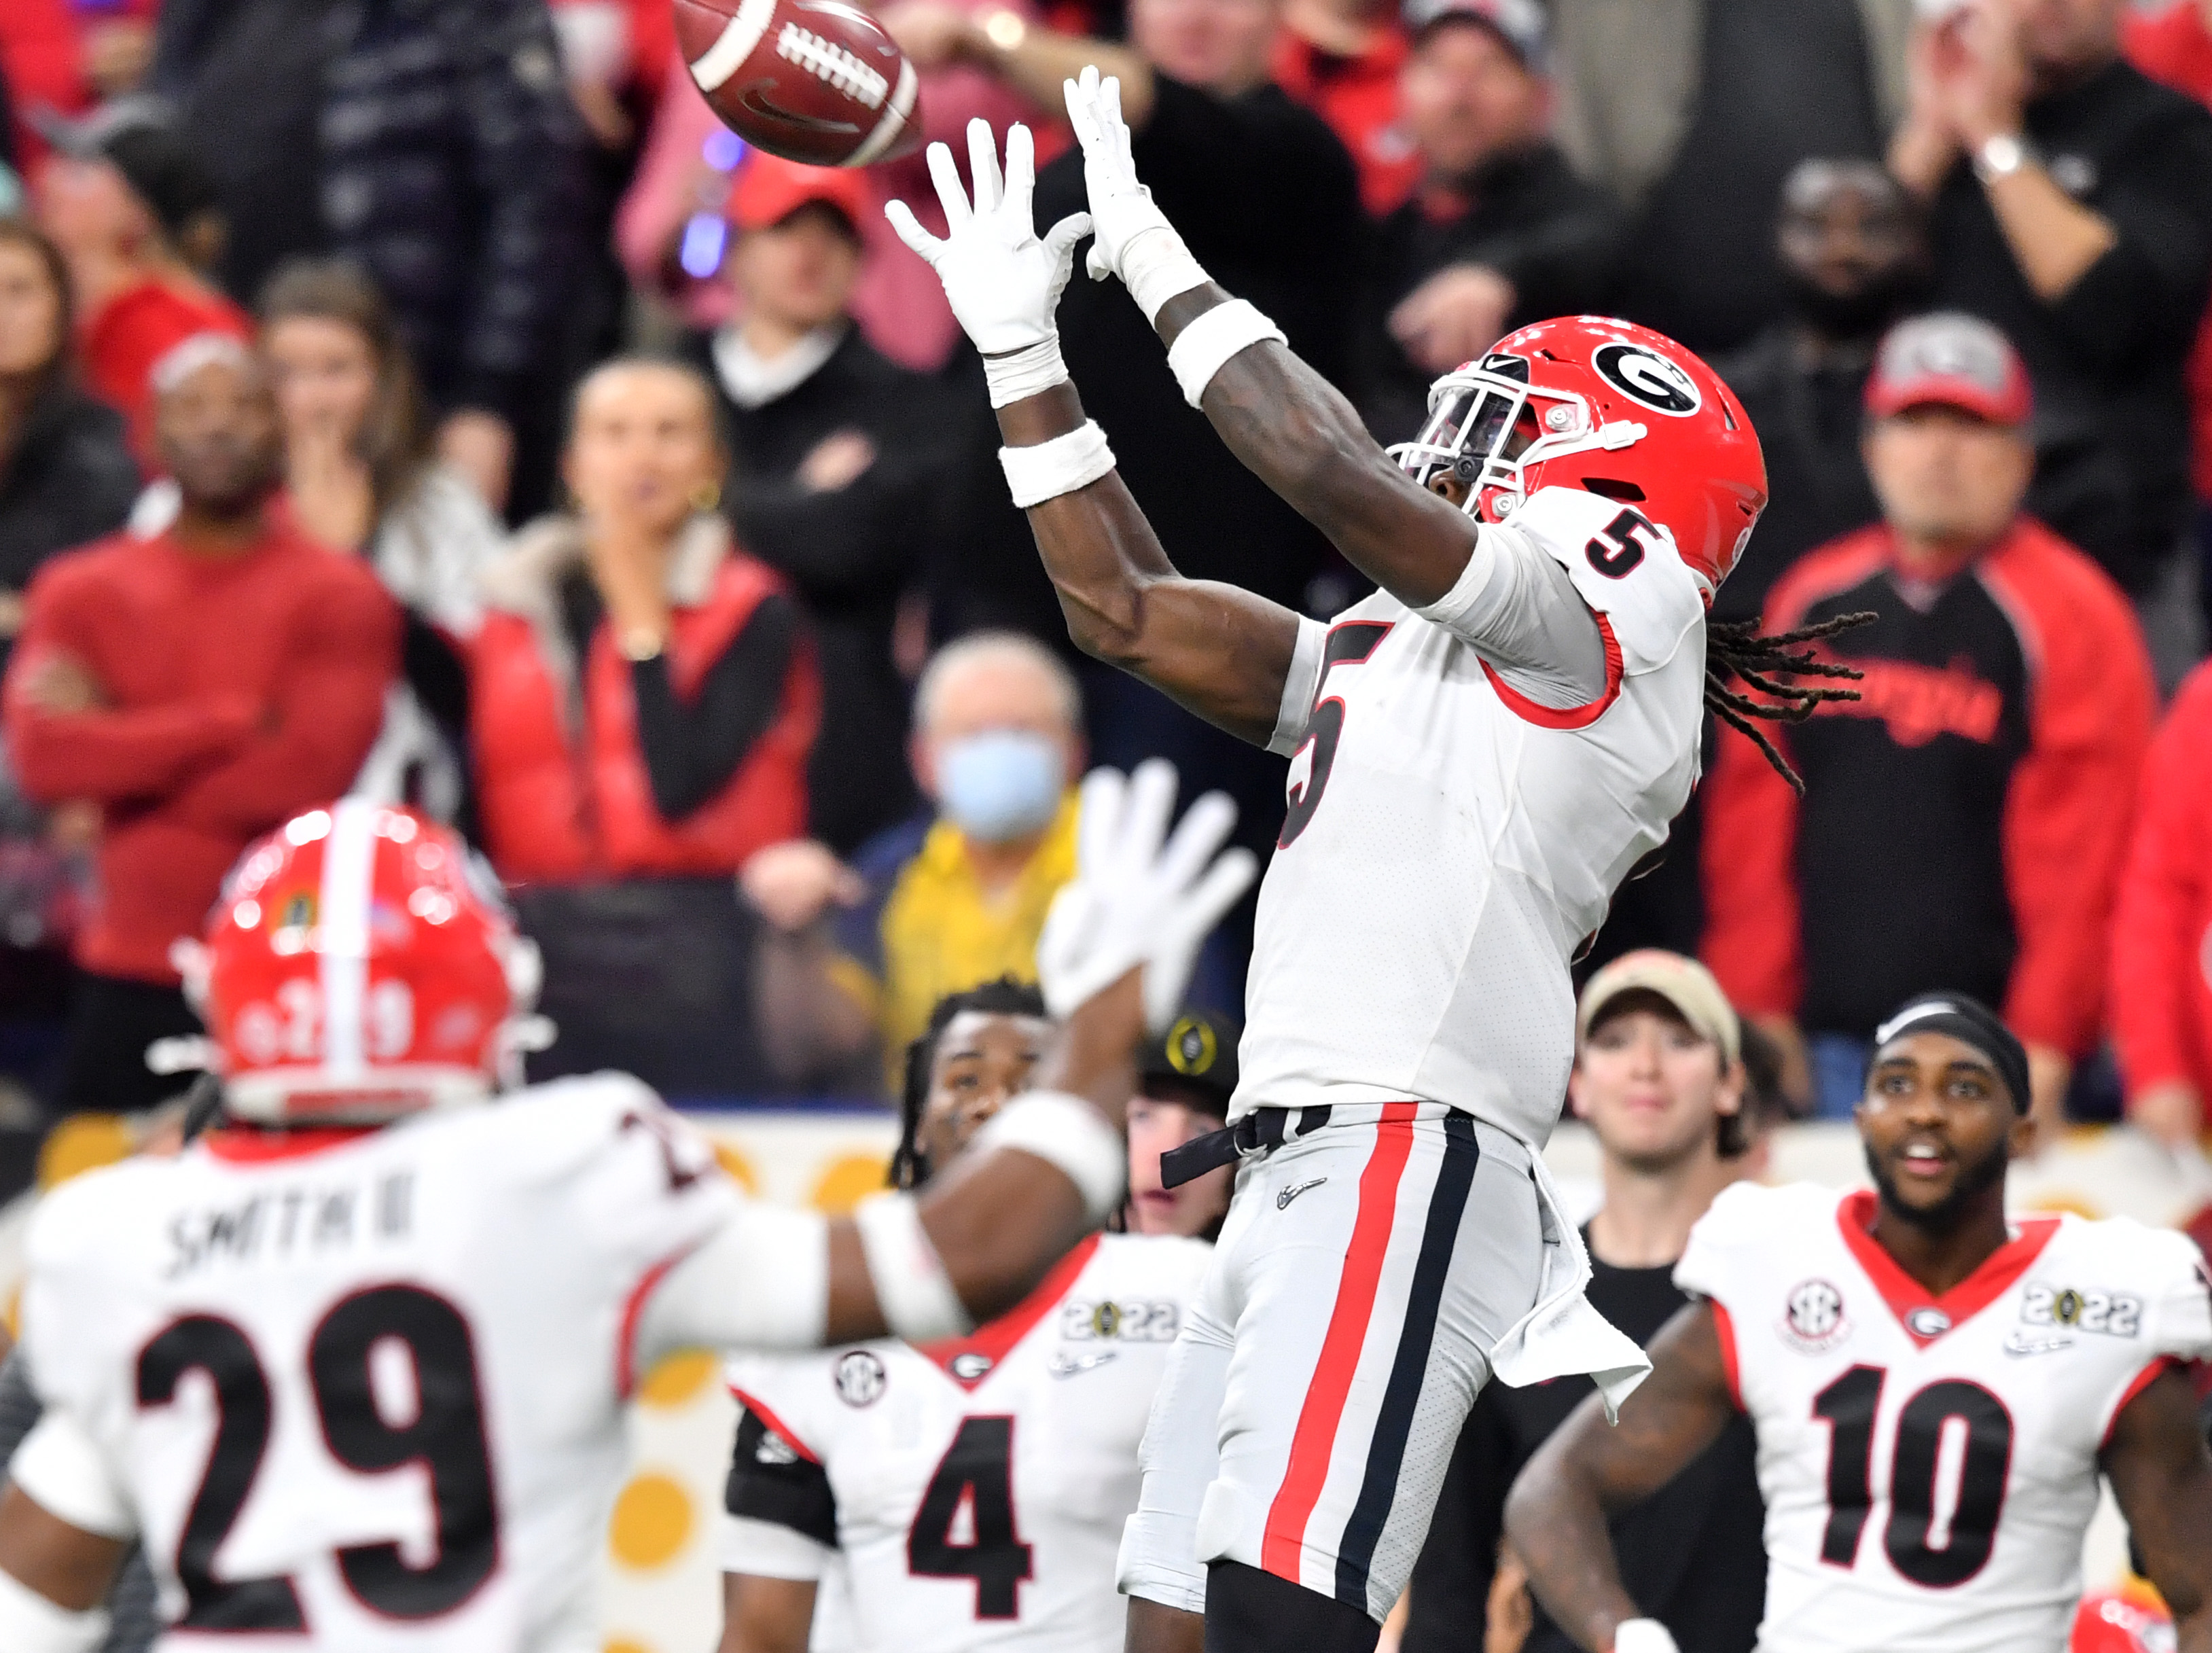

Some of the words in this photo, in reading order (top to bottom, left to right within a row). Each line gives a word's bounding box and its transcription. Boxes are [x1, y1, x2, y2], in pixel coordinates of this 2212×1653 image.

[1585, 508, 1664, 580] 5
[1277, 619, 1395, 850] 5
[160, 1188, 359, 1283] SMITH
[135, 1283, 504, 1636] 29
[906, 1415, 1034, 1621] 4
[1810, 1363, 2014, 1590] 10
